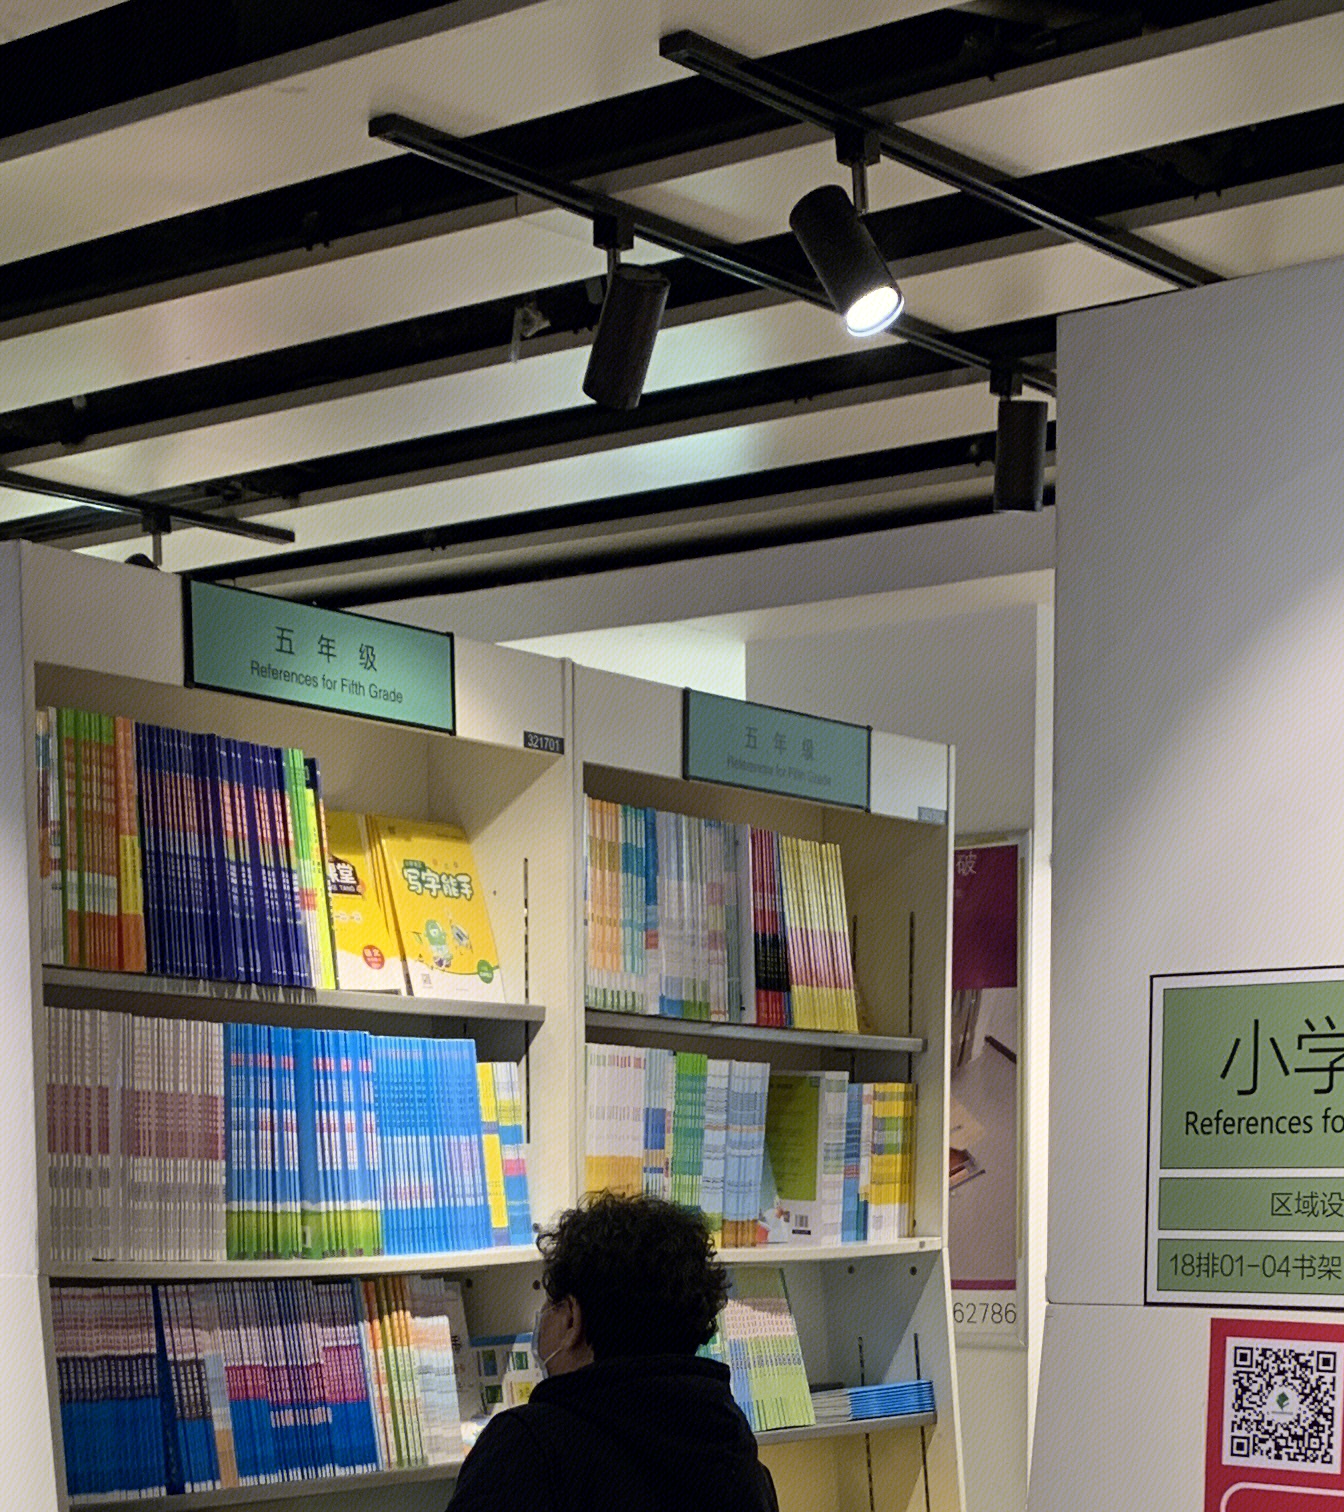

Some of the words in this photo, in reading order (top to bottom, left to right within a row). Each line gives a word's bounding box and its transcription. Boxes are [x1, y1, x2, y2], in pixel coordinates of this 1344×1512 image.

[275, 626, 377, 672] 五年级
[250, 660, 319, 687] References
[322, 674, 337, 690] for
[340, 677, 365, 697] Fifth
[368, 684, 403, 703] Grade
[528, 734, 561, 752] 321701
[744, 726, 816, 760] 五年级
[956, 850, 977, 877] 破
[403, 867, 473, 901] 写字能手
[1185, 1109, 1313, 1136] References
[1169, 1252, 1343, 1281] 18排01-04书架
[953, 1301, 1016, 1325] 62786
